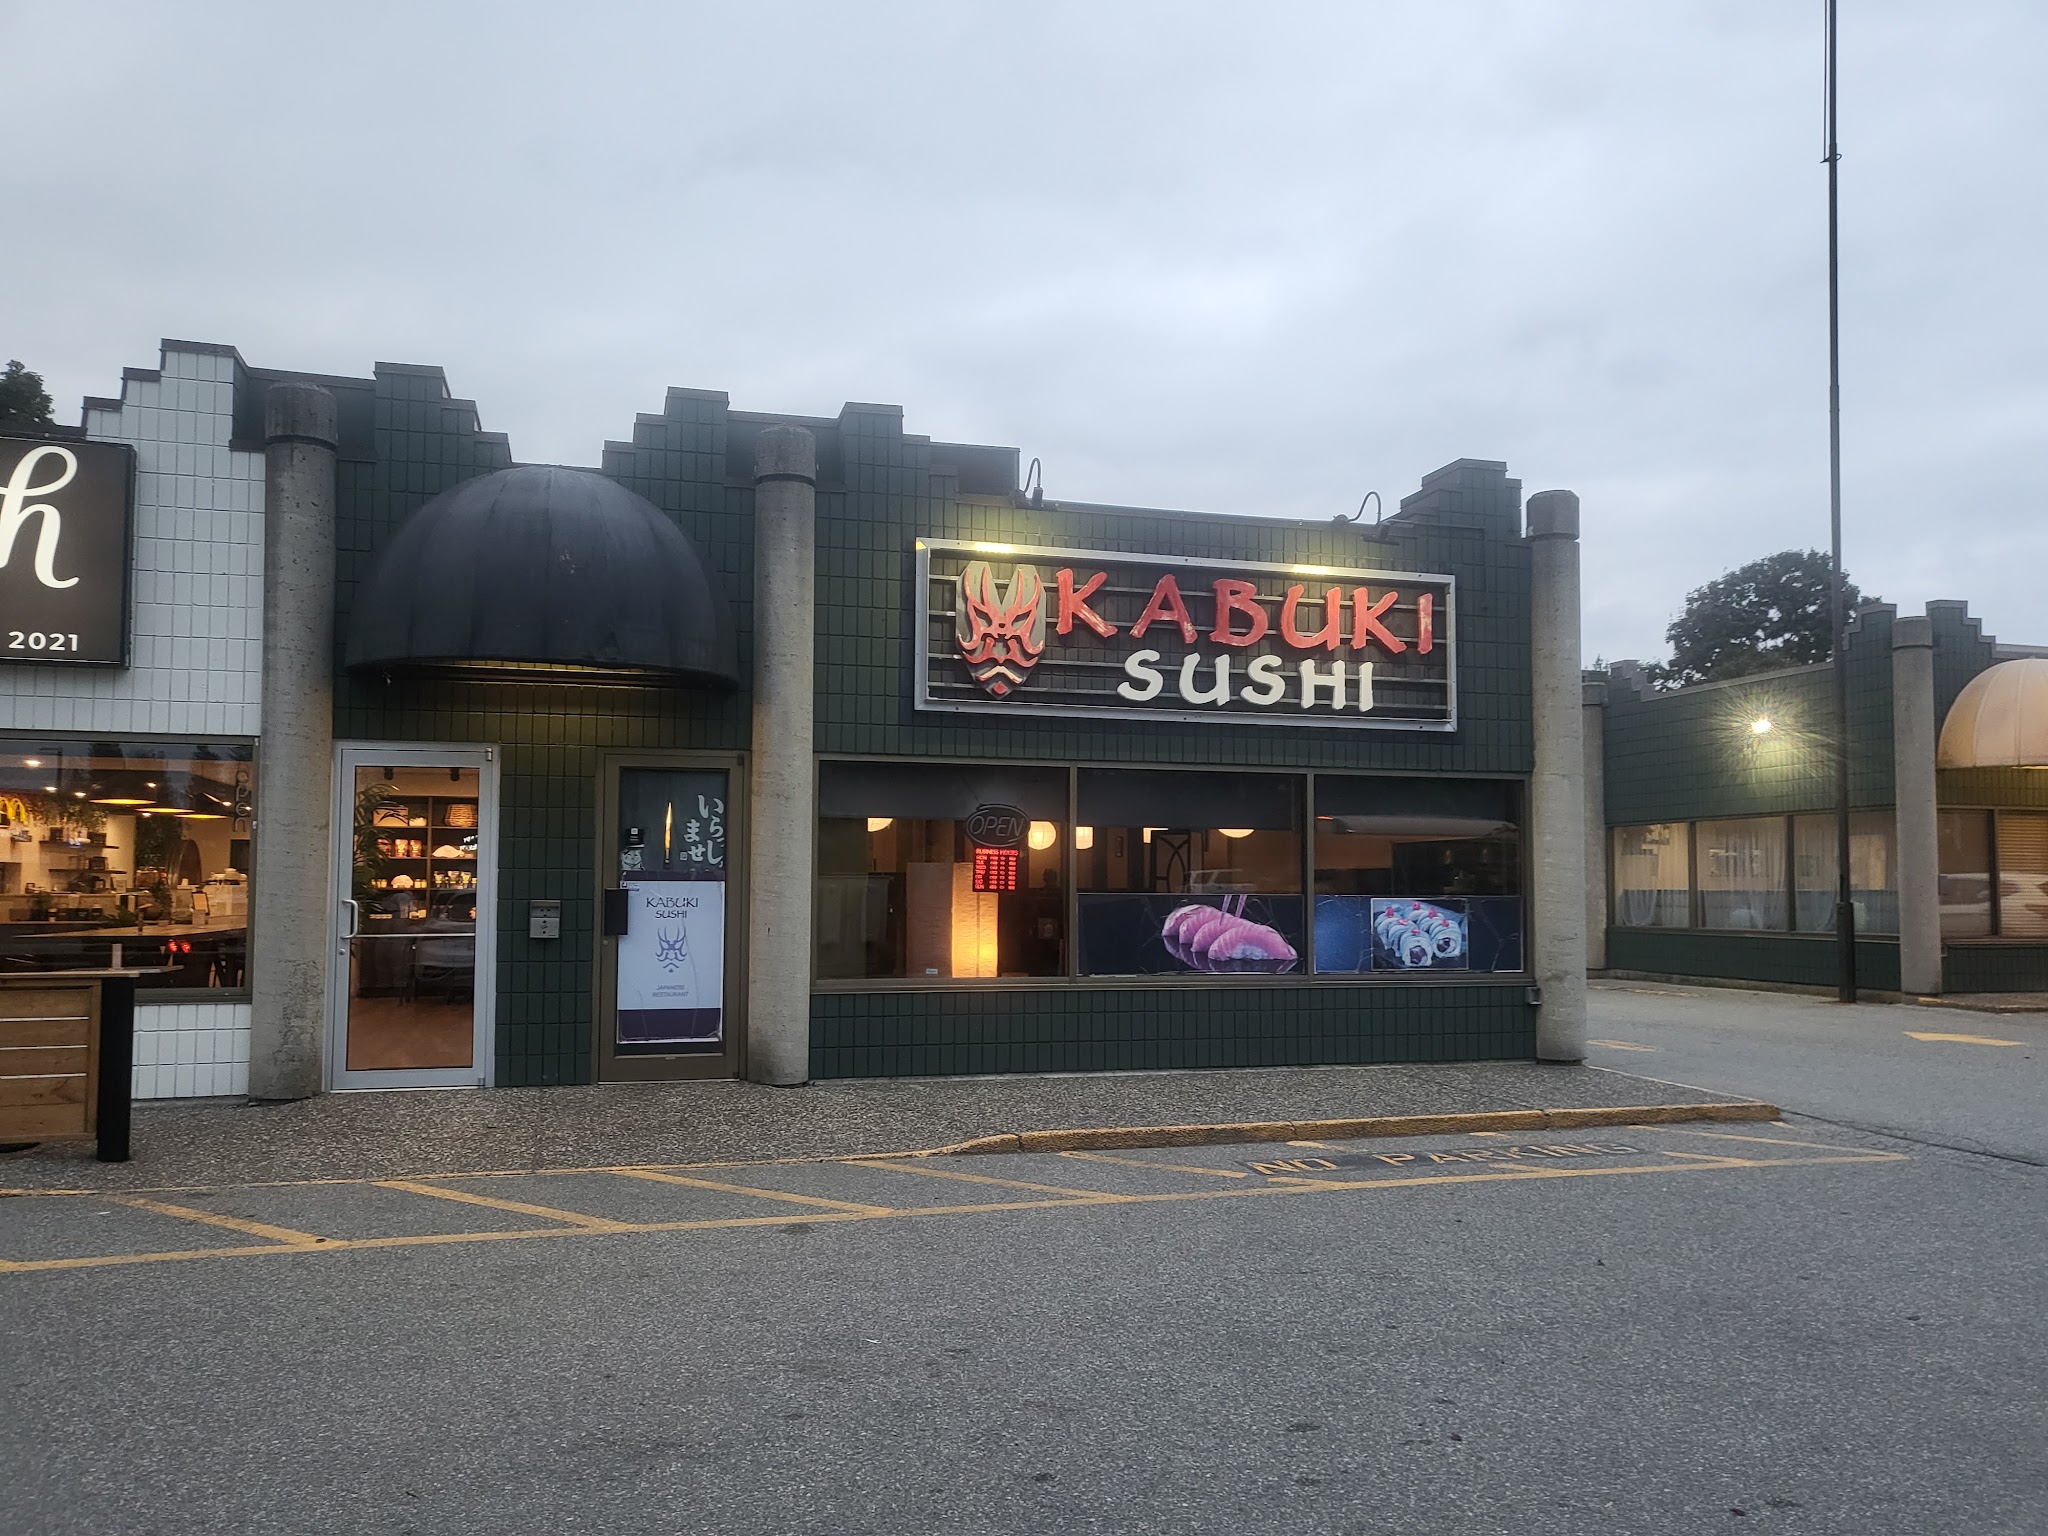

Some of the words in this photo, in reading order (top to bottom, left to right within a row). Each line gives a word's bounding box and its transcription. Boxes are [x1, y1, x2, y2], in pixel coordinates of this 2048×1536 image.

[1055, 567, 1433, 654] KABUKI
[8, 631, 78, 651] 2021
[1117, 648, 1375, 712] SUSHI
[969, 815, 1024, 837] OPEN
[646, 897, 699, 908] KABUKI
[655, 910, 688, 919] SUSHI
[1250, 1157, 1339, 1176] NO
